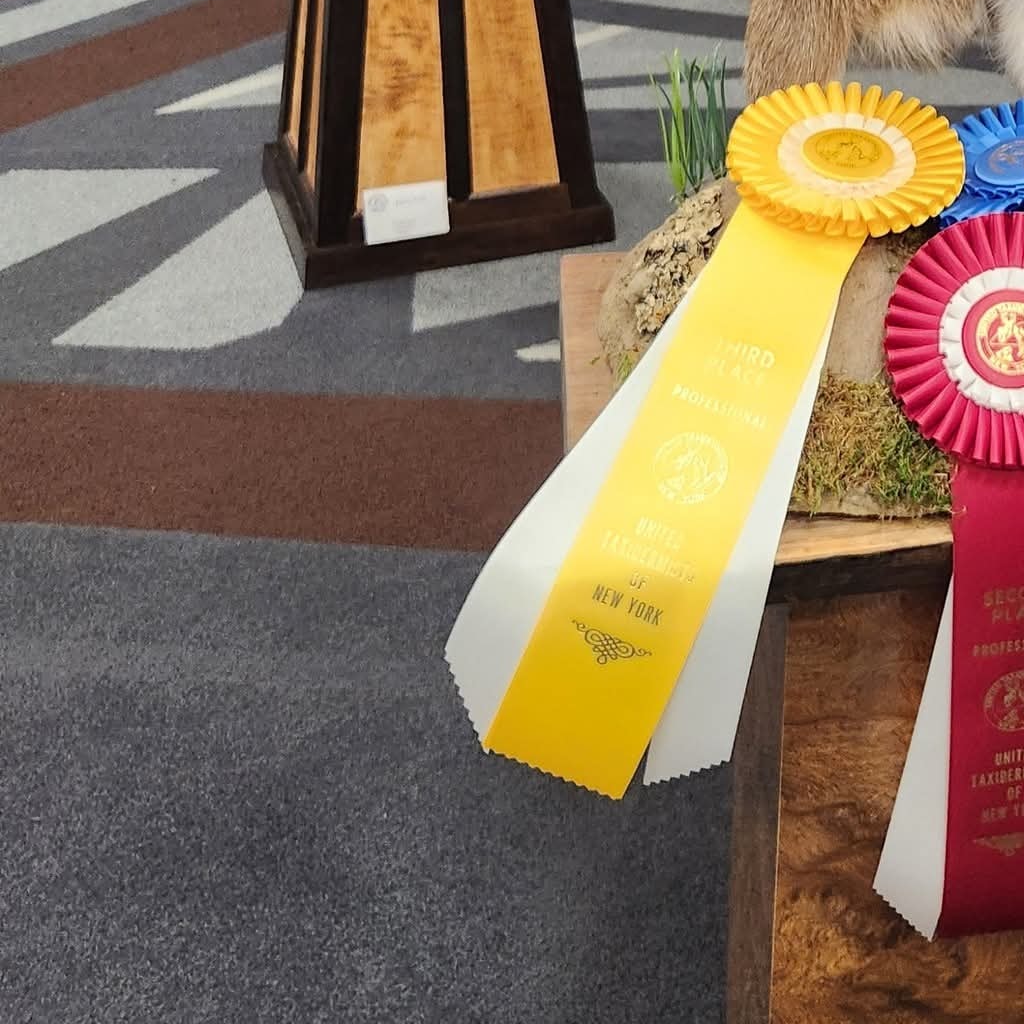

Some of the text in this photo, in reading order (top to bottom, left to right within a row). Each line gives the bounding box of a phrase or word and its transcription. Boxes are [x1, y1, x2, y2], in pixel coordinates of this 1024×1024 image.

[628, 571, 649, 590] OF
[592, 584, 664, 626] NEW YORK
[1007, 786, 1023, 800] OF
[980, 806, 1007, 823] NEW
